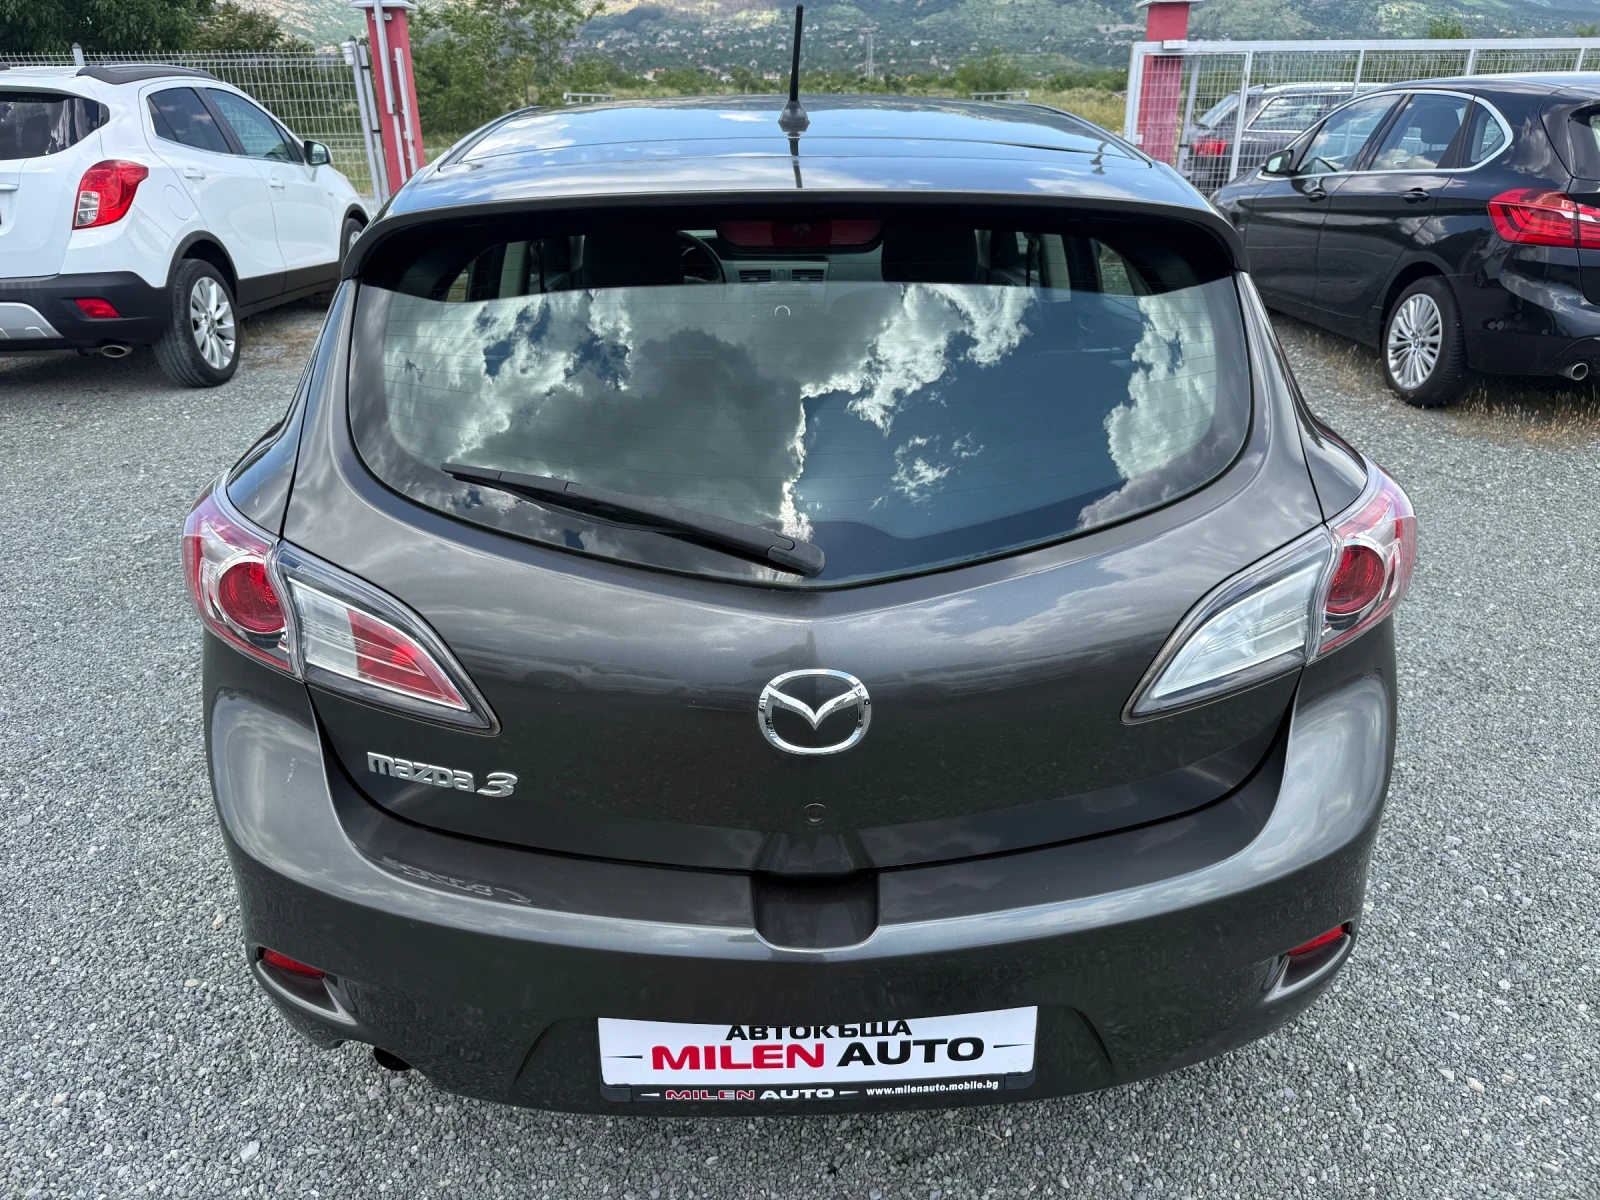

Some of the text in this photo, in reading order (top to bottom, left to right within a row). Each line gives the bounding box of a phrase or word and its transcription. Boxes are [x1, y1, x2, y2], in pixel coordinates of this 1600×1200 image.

[476, 771, 519, 798] 3
[651, 1036, 985, 1070] MILEN AUTO
[665, 1088, 835, 1100] MILEN AUTO
[866, 1080, 999, 1096] www.milenauto.mobile.bg
